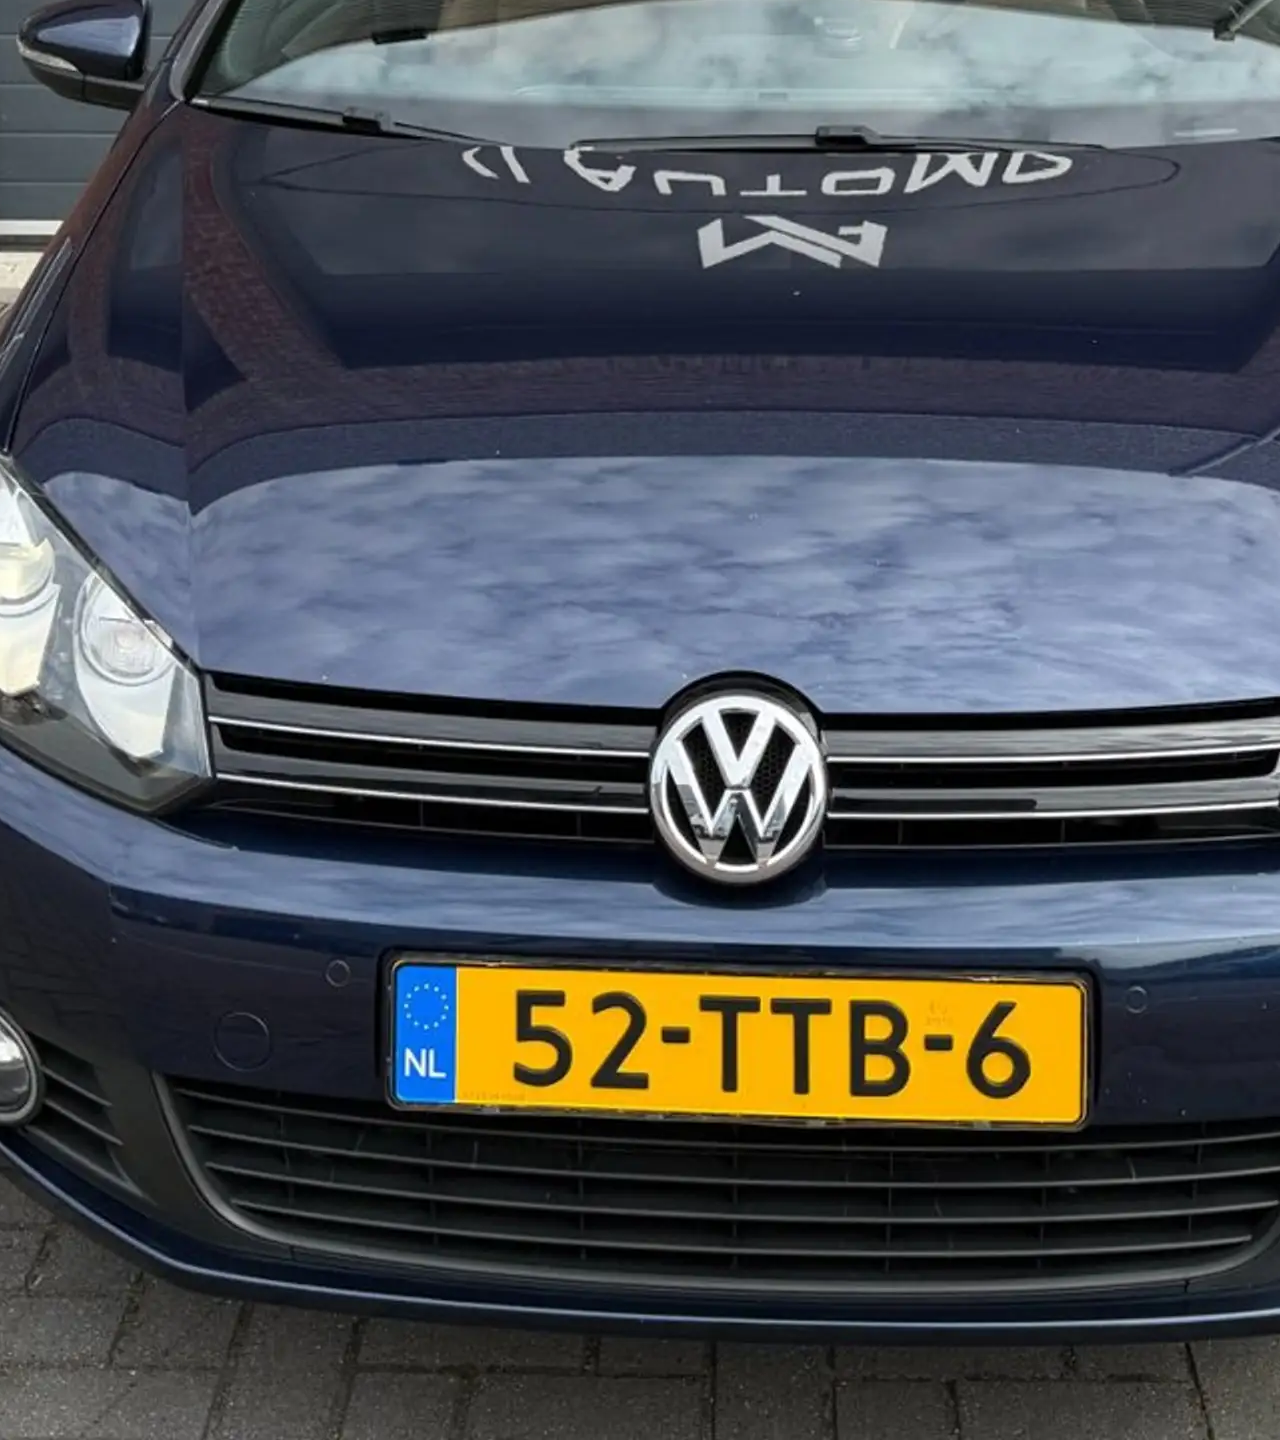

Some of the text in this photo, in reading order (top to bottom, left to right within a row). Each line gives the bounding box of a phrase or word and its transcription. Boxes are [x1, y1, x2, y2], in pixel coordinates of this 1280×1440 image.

[652, 697, 825, 880] VW
[404, 1048, 448, 1079] NL
[513, 989, 1032, 1099] 52-TTB-6
